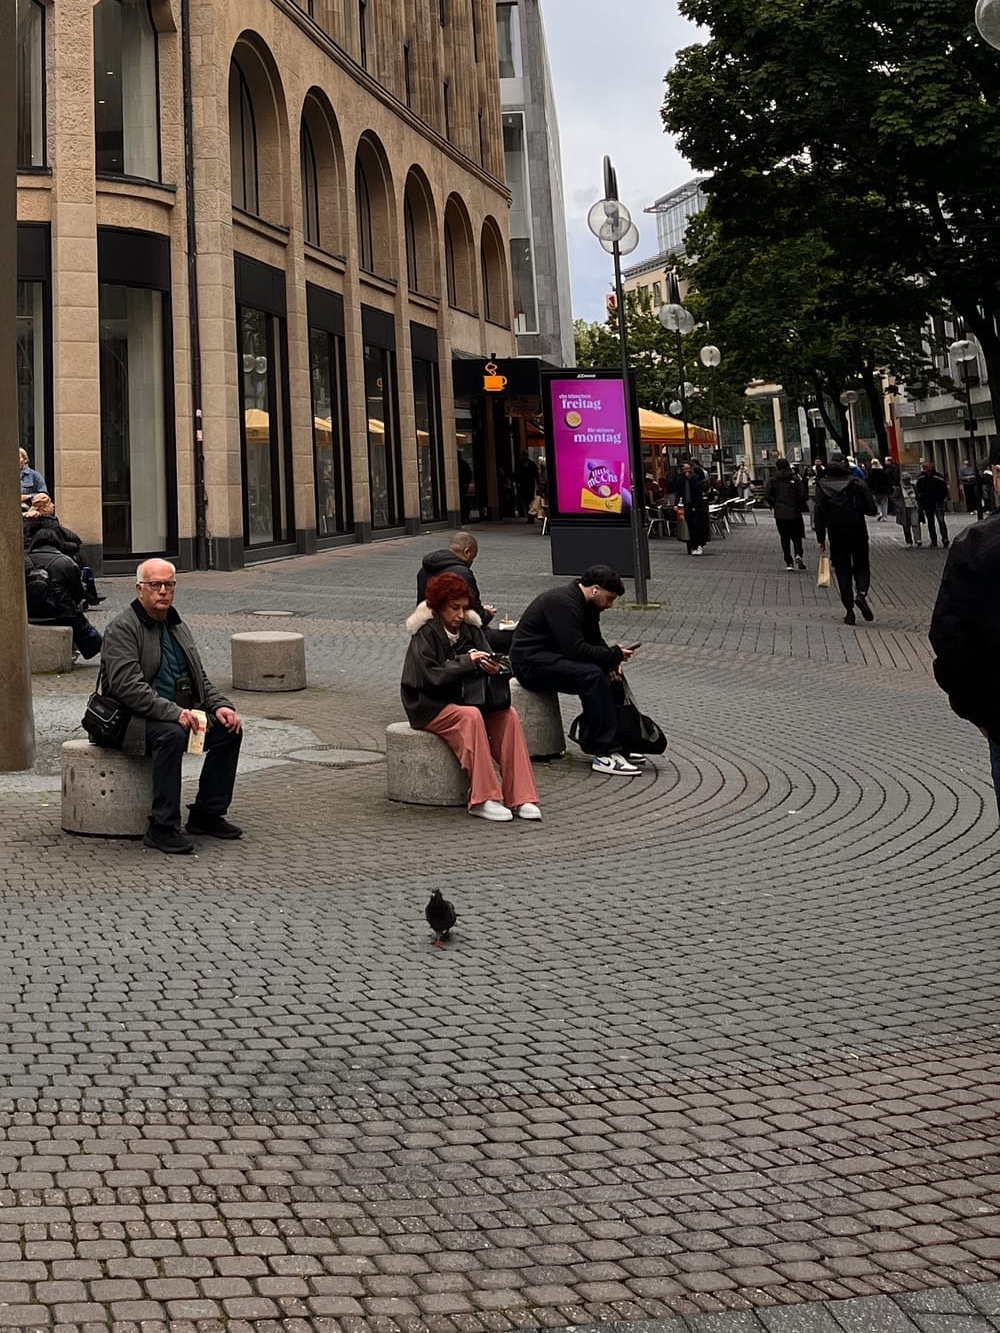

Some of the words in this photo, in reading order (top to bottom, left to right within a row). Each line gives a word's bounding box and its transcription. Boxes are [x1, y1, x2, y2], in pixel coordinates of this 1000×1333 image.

[562, 398, 601, 410] freitag
[574, 433, 622, 444] montag
[592, 467, 610, 478] little
